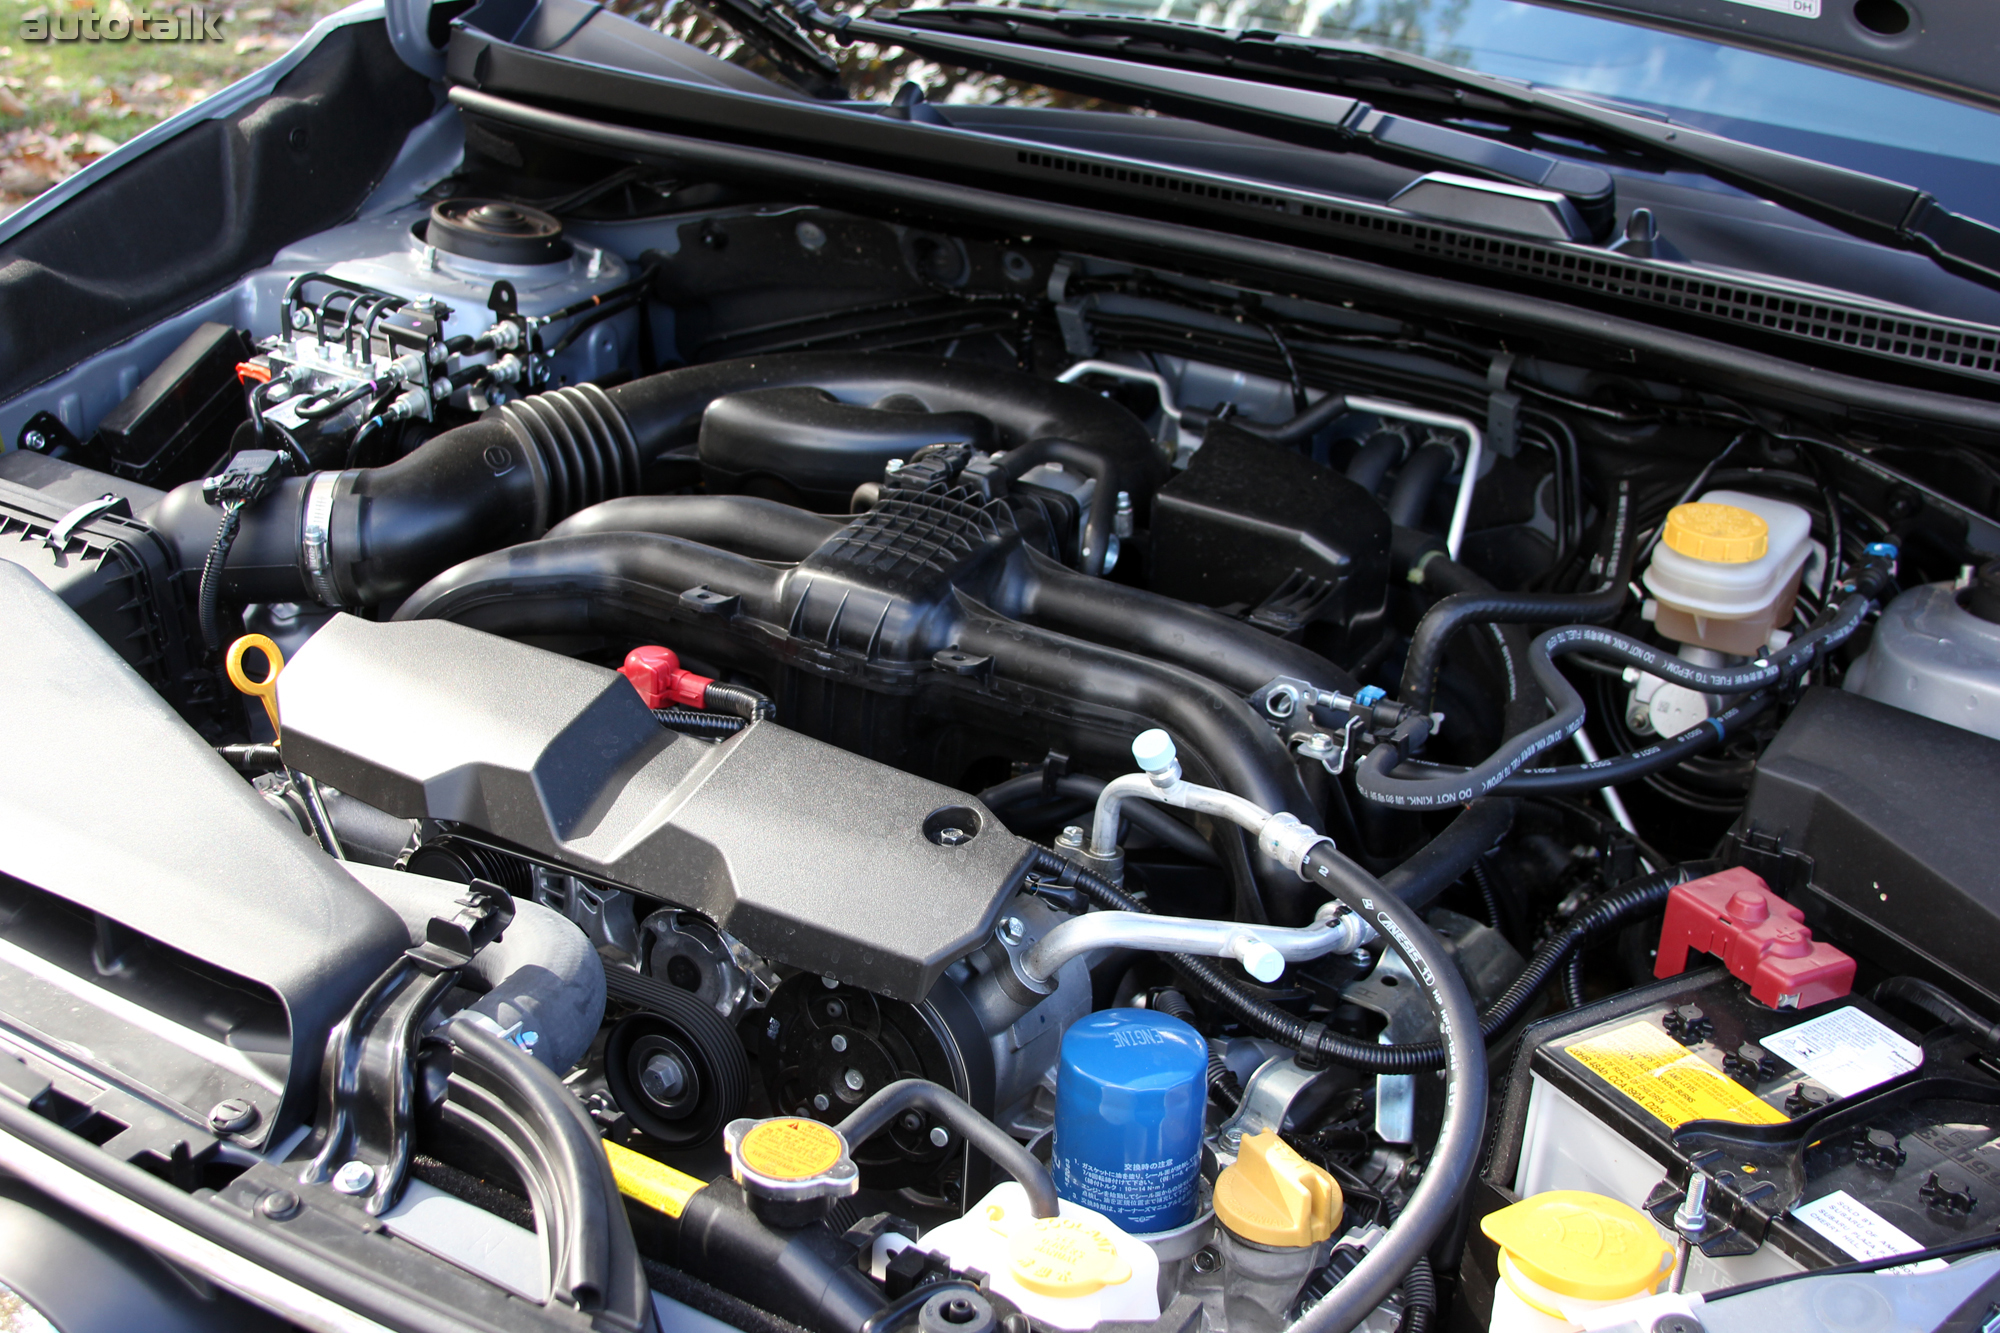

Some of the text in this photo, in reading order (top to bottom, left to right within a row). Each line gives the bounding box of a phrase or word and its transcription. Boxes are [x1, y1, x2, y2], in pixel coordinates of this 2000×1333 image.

[1711, 676, 1732, 686] FUEL
[1436, 793, 1456, 804] NOT
[1459, 788, 1472, 800] DO
[1318, 866, 1329, 877] 2
[1432, 989, 1442, 1005] HP
[1108, 1028, 1164, 1048] ENGINE
[1605, 1074, 1629, 1088] CCA
[1826, 1203, 1865, 1229] SUBARU
[1863, 1228, 1878, 1238] OF
[1835, 1200, 1876, 1227] SOLD BY
[1808, 1211, 1842, 1234] CHERRY
[1816, 1207, 1851, 1231] SUBARU
[1849, 1230, 1877, 1249] PLAZA
